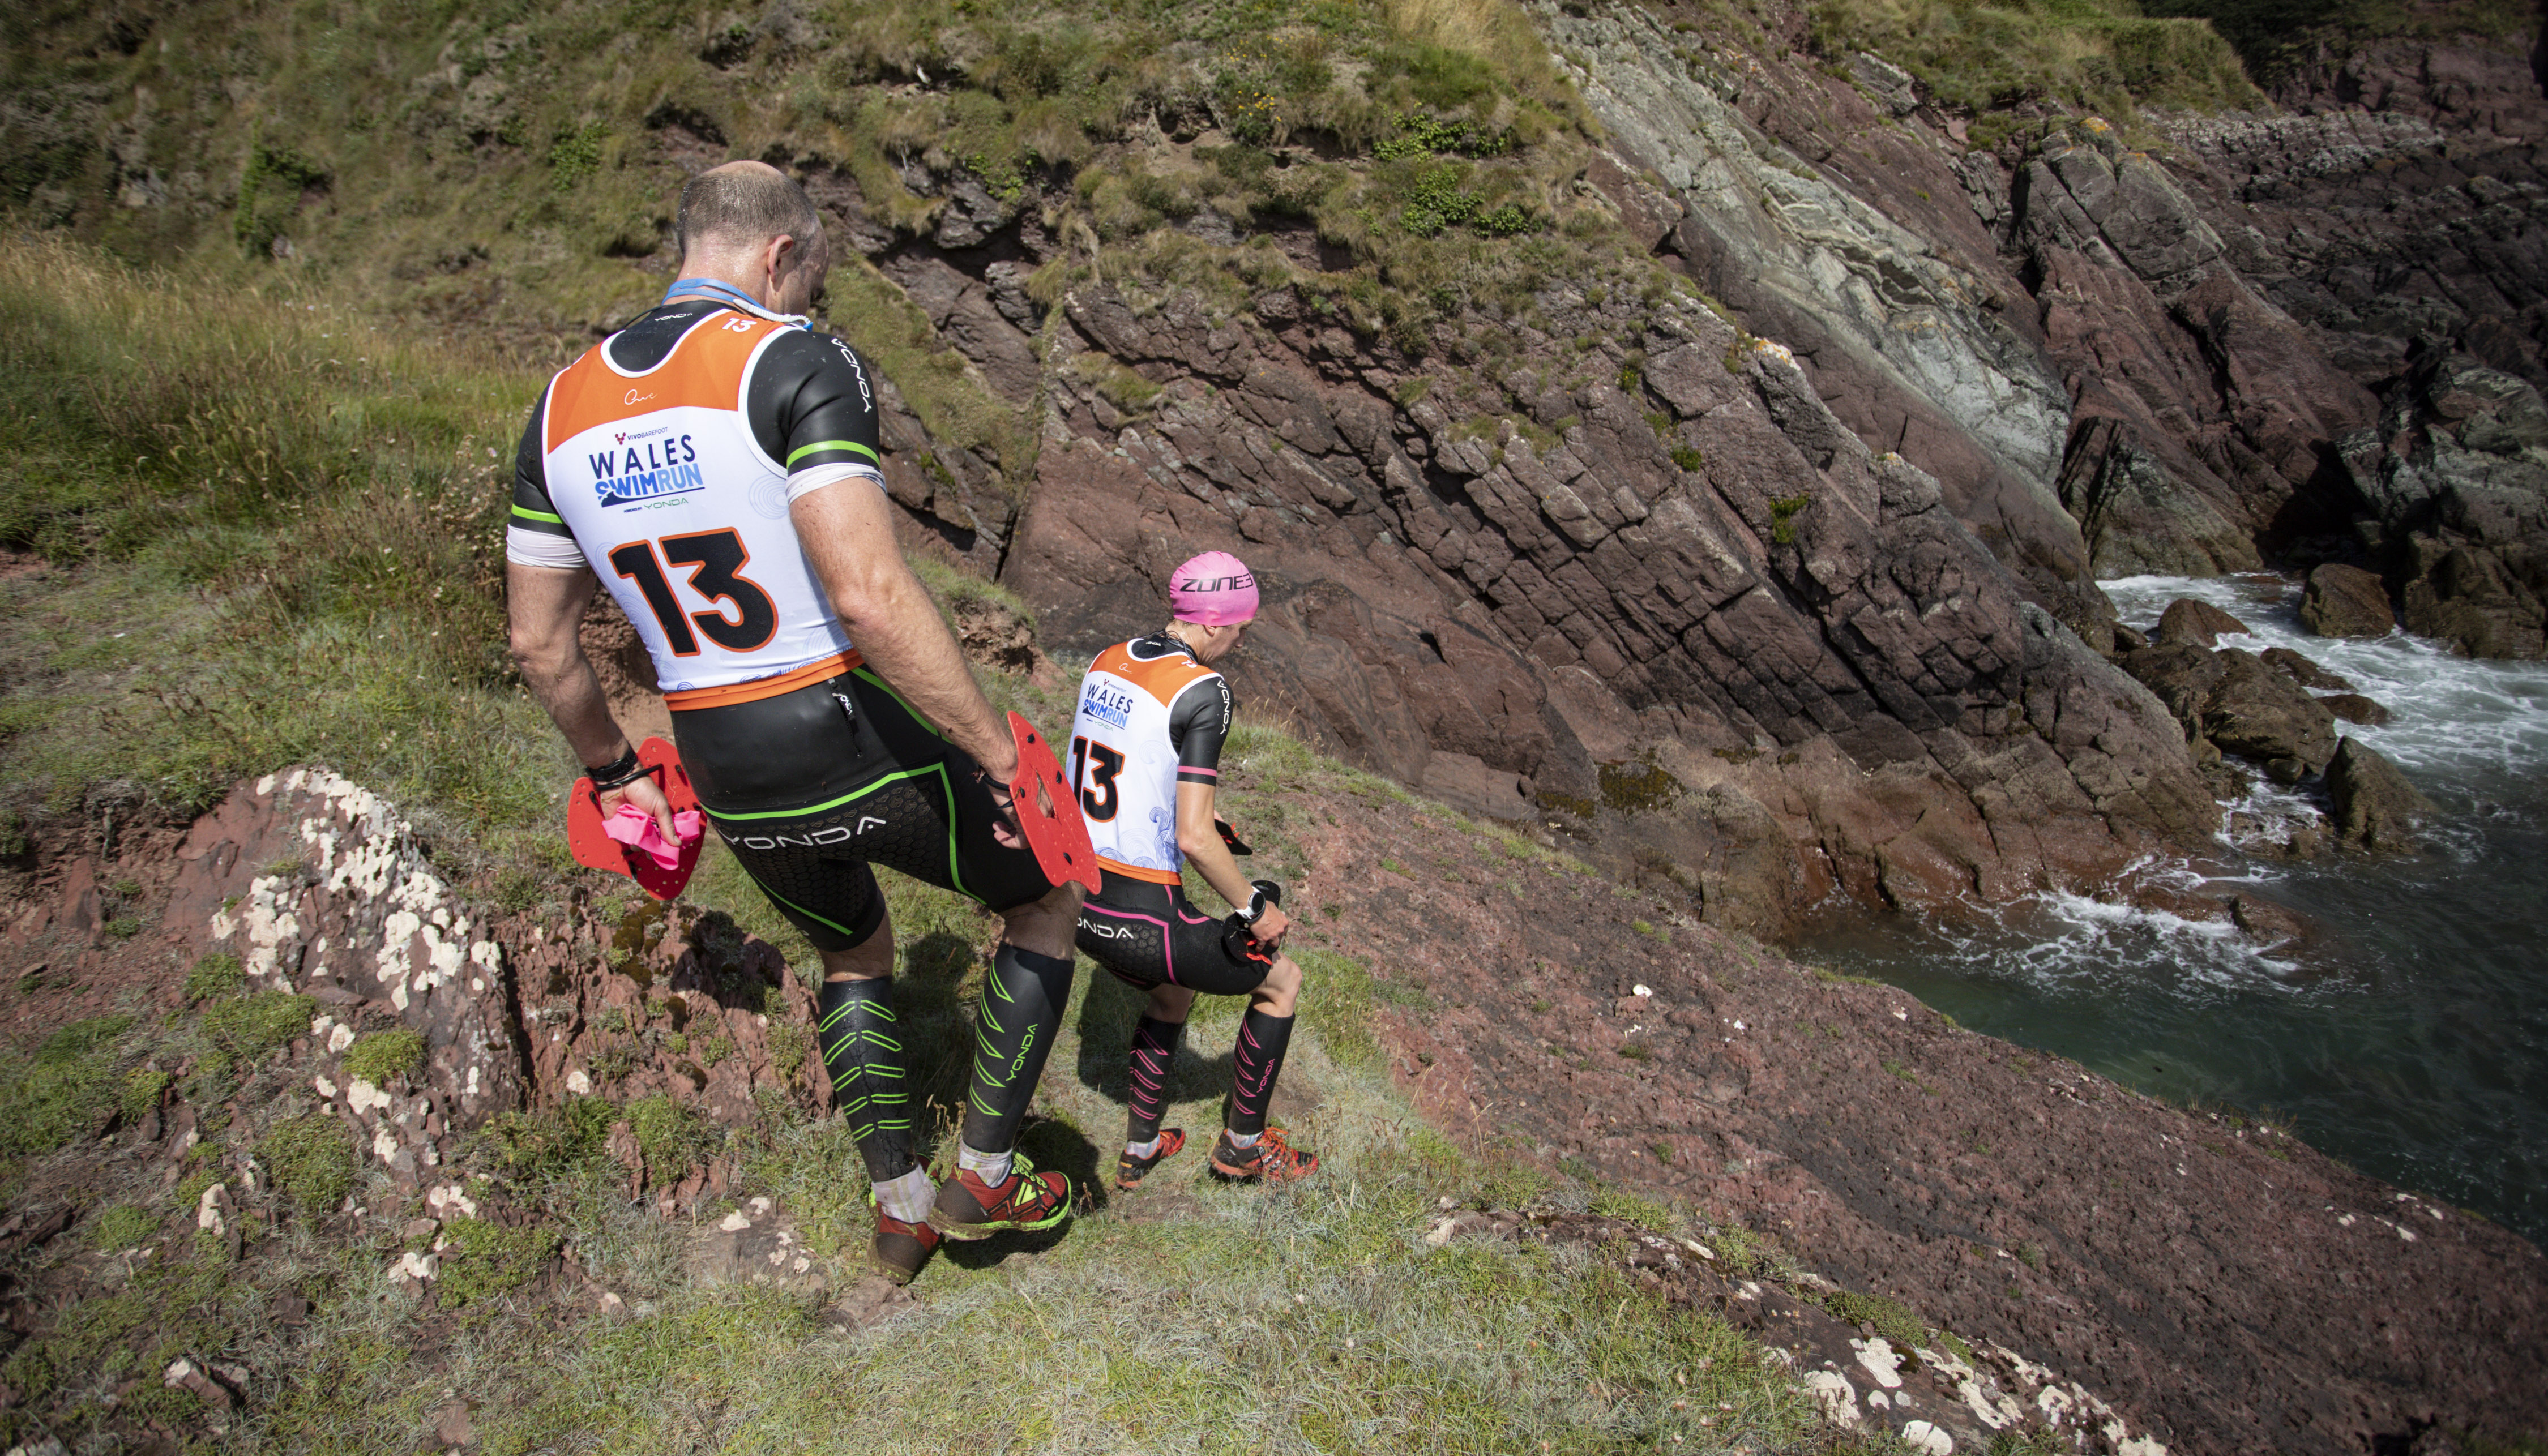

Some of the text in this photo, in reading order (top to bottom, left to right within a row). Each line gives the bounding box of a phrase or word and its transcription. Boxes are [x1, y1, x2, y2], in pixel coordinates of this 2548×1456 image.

[655, 313, 692, 322] YONDA
[722, 318, 757, 332] 13
[831, 338, 872, 413] YONDA
[627, 427, 668, 440] VIVOBAREFOOT
[589, 434, 695, 479] WALES
[595, 463, 704, 500] SWIMRUN
[644, 498, 689, 510] YONDA
[608, 527, 779, 657] 13
[1179, 573, 1254, 592] ZONE3
[1083, 699, 1128, 727] SWIMRUN
[1087, 683, 1134, 714] WALES
[1217, 680, 1230, 734] YONDA
[1094, 720, 1113, 731] YONDA
[1073, 735, 1126, 823] 13
[718, 816, 886, 849] YONDA
[1006, 1024, 1038, 1081] YONDA
[1256, 1059, 1275, 1093] YONDA
